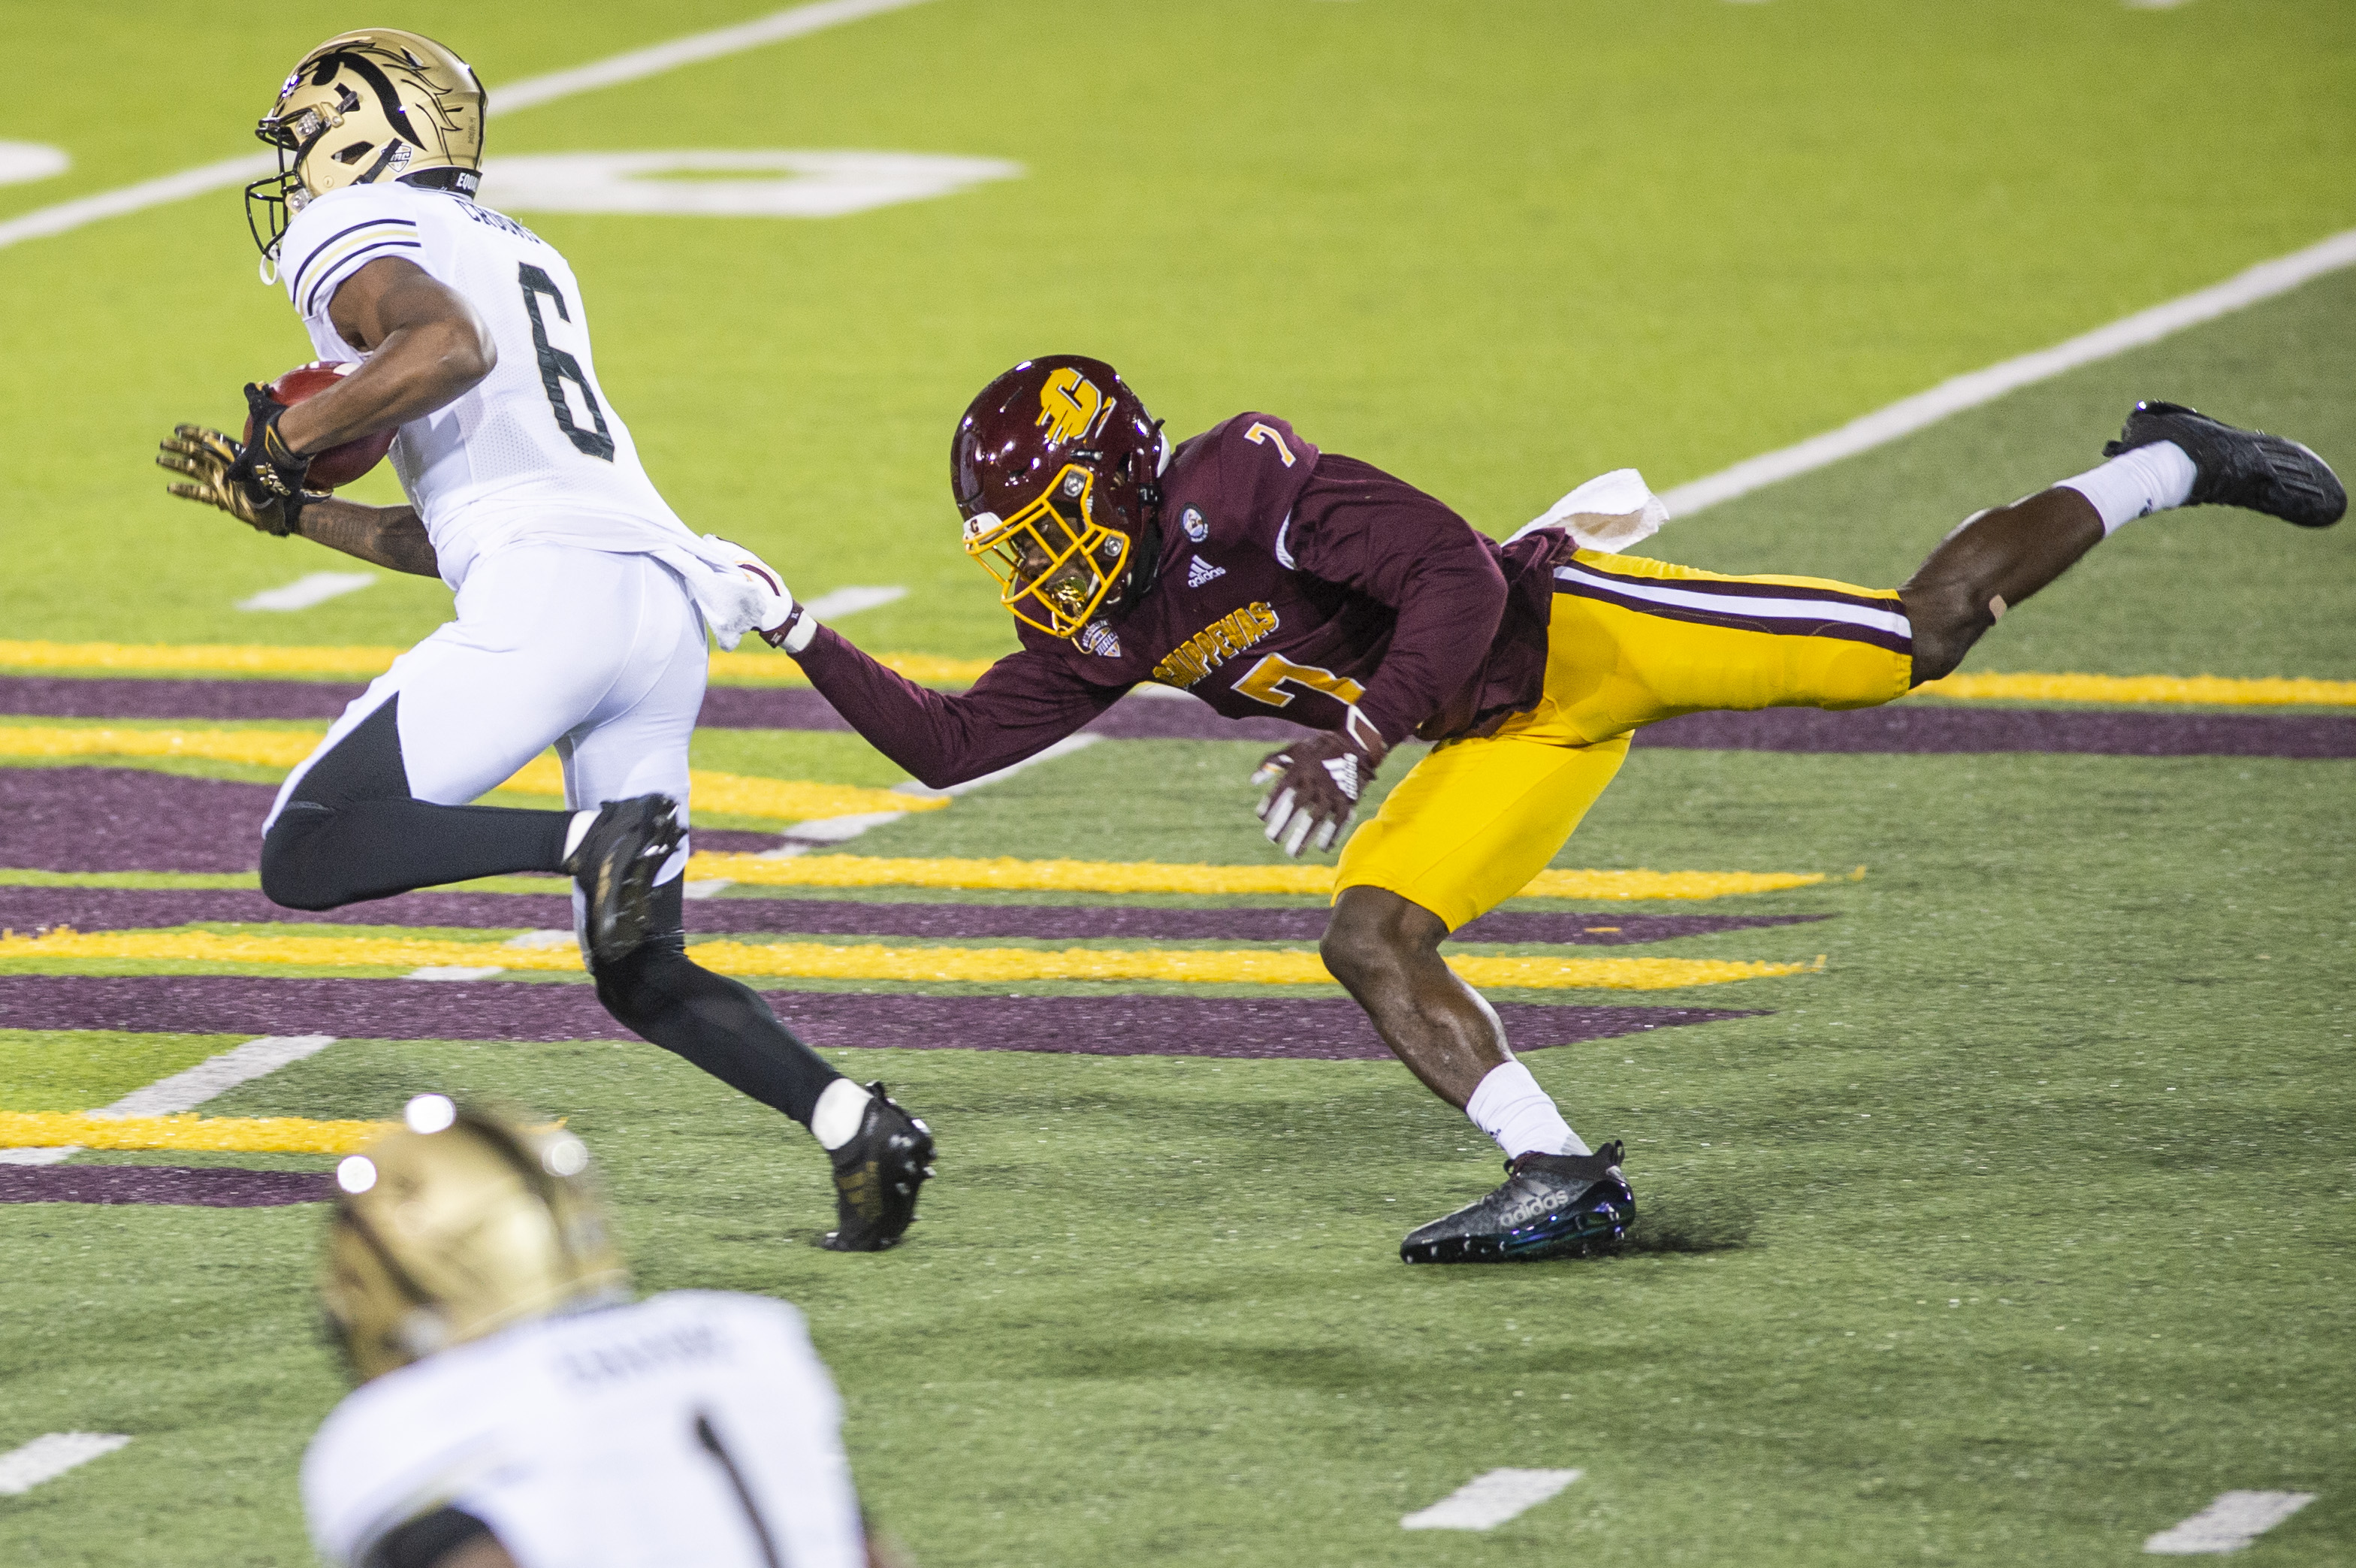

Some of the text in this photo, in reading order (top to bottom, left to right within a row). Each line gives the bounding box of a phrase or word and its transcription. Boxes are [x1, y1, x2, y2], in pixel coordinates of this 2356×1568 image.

[518, 261, 615, 464] 6
[1244, 421, 1296, 468] 7
[1188, 566, 1226, 588] adidas
[1231, 651, 1366, 708] 7
[1499, 1189, 1570, 1228] adidas
[690, 1406, 781, 1568] 1
